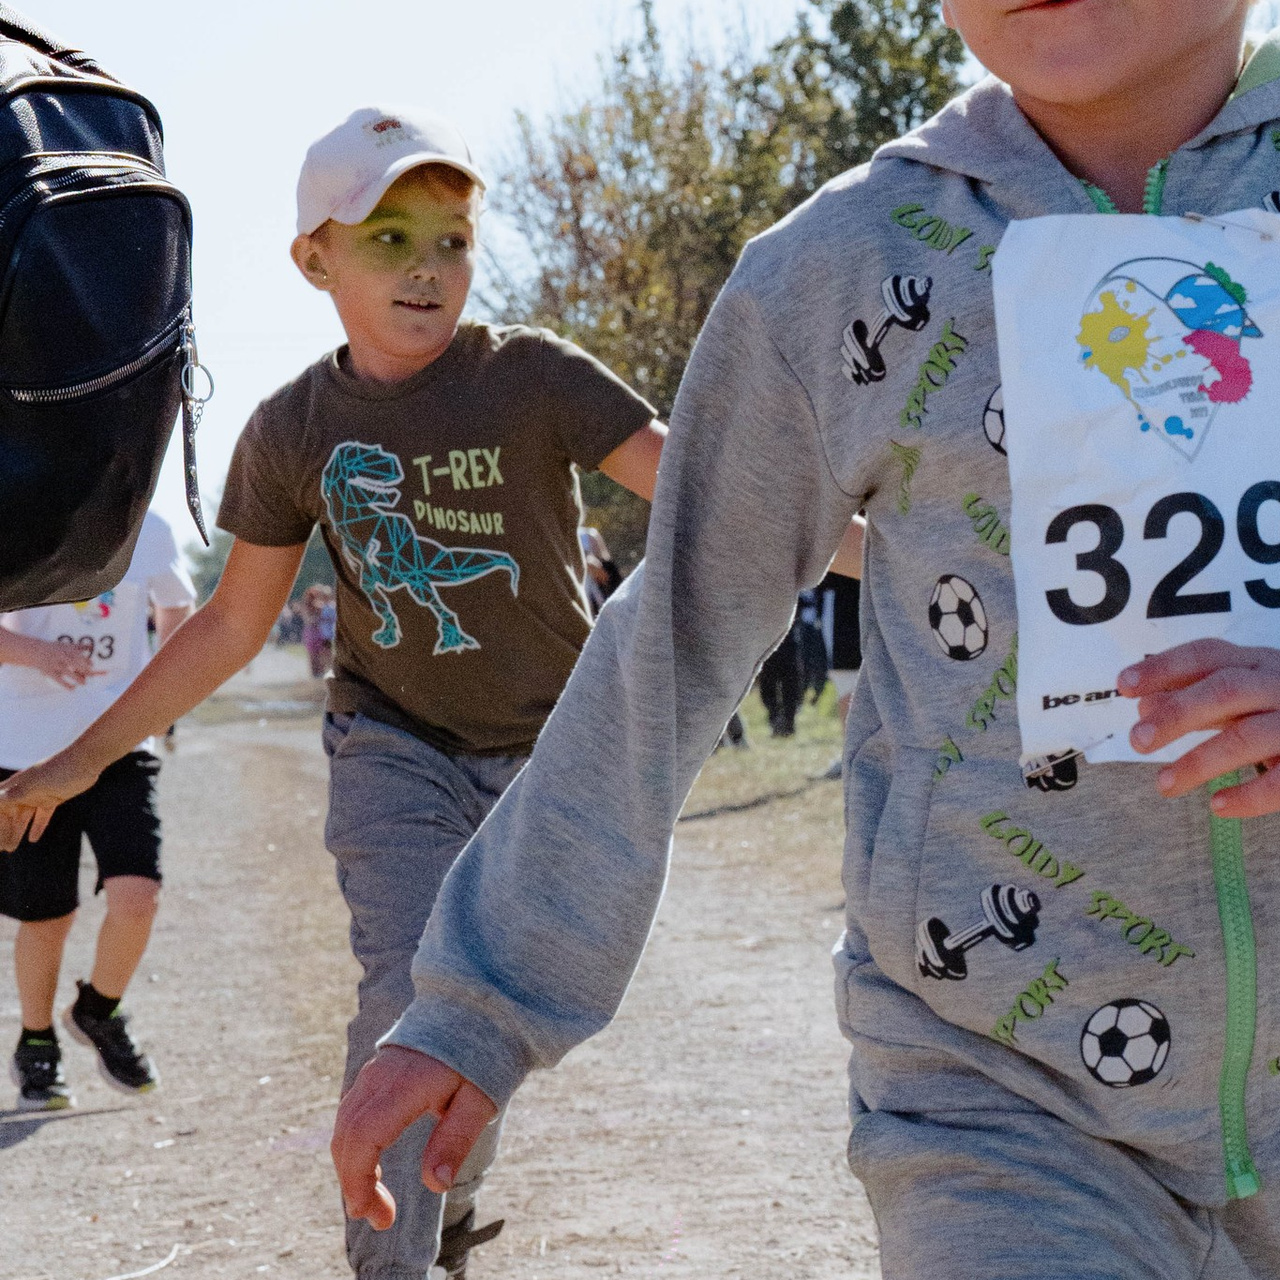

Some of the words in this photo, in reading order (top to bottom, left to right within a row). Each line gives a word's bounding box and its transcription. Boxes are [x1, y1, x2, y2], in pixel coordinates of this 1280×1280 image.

[901, 318, 968, 430] SPORT
[412, 446, 504, 495] T-REX
[413, 499, 504, 535] DINOSAUR
[1042, 694, 1080, 711] be
[1084, 890, 1196, 967] SPORT
[991, 957, 1069, 1046] PORT
